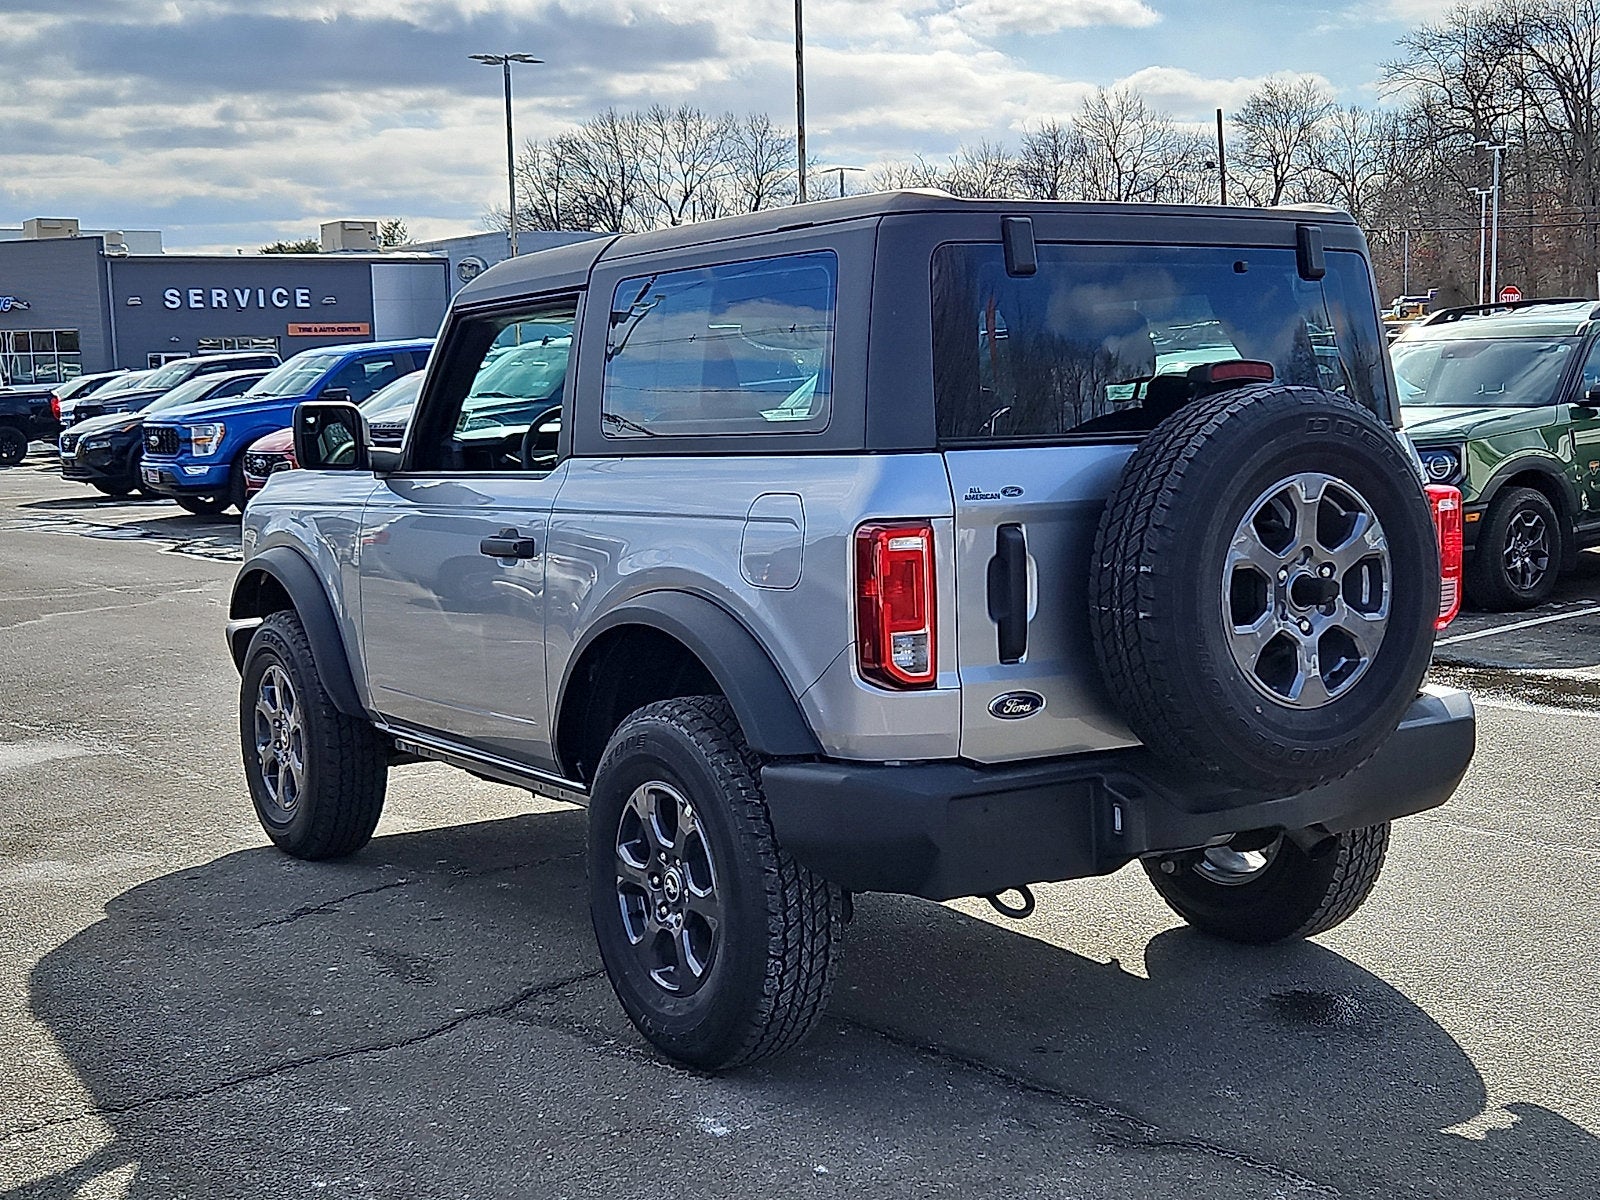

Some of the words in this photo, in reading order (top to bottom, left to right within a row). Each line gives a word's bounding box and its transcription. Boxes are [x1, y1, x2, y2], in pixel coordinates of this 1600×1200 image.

[164, 287, 311, 309] SERVICE
[1501, 293, 1520, 302] STOP
[969, 486, 982, 494] ALL
[964, 492, 1001, 501] AMERICAN
[1003, 698, 1032, 714] Ford
